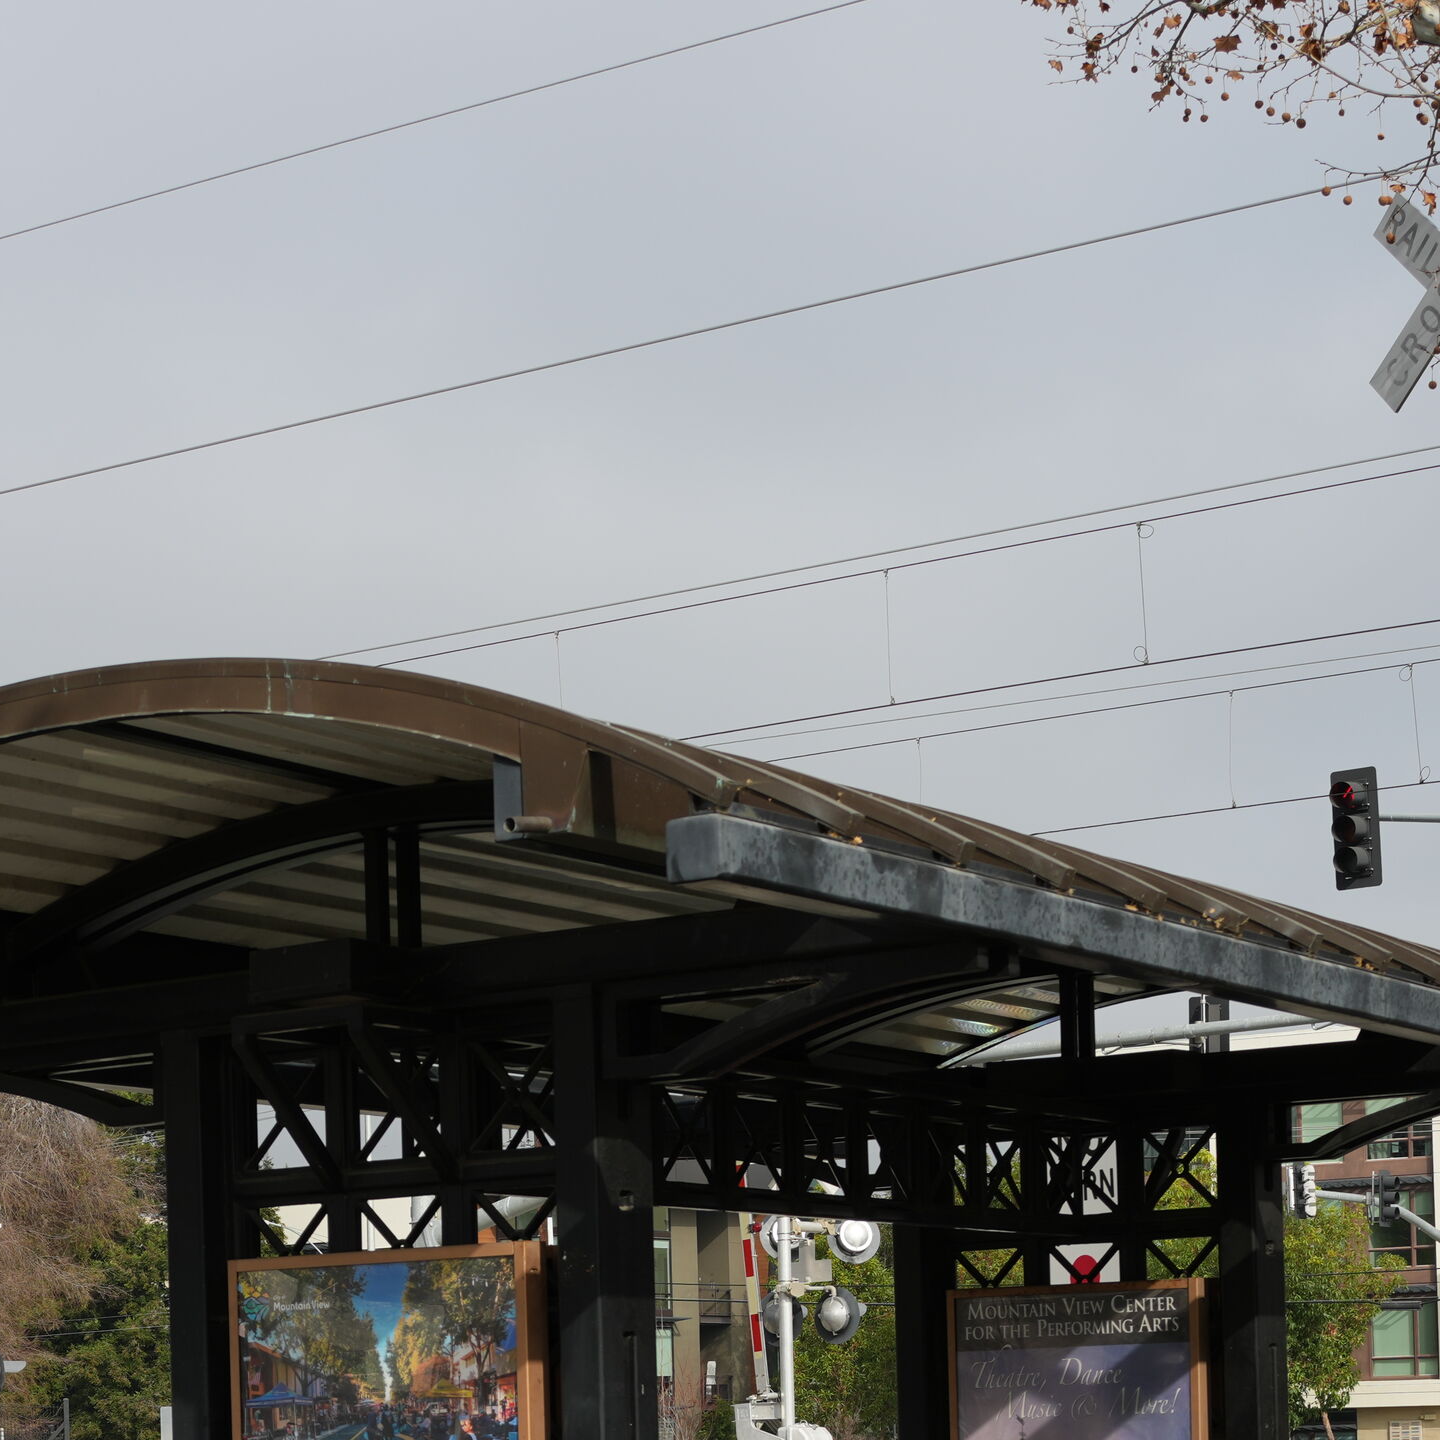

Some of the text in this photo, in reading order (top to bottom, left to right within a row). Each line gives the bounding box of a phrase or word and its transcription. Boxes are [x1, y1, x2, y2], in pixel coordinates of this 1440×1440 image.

[971, 1357, 1123, 1392] Theatre, Dance
[995, 1391, 1063, 1422] Music
[1109, 1388, 1181, 1416] More!
